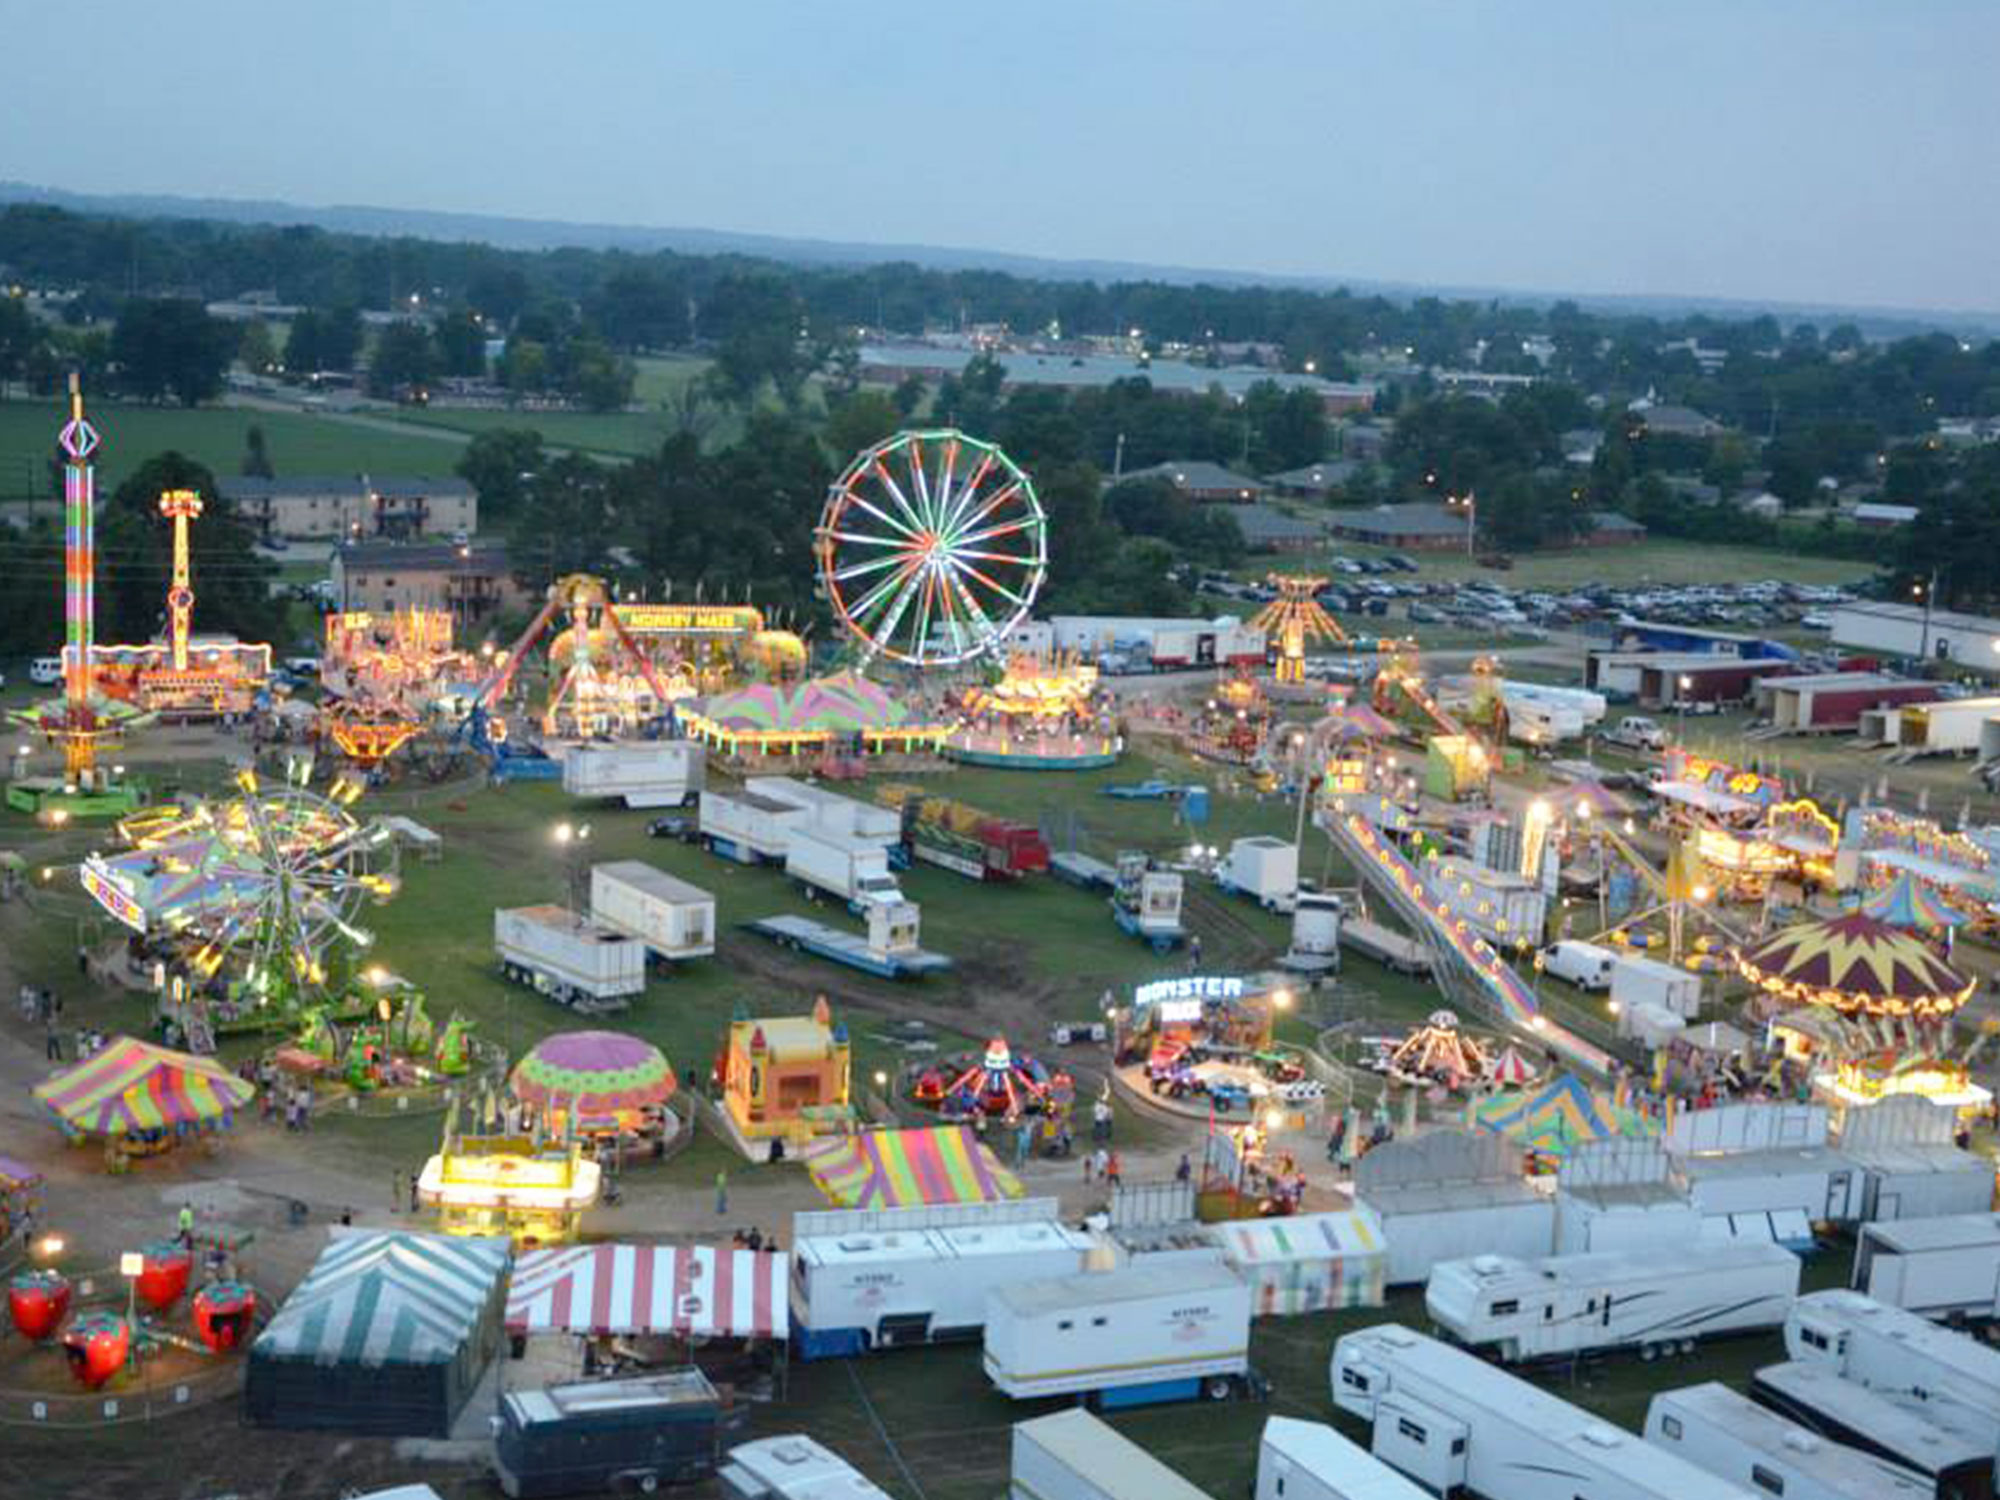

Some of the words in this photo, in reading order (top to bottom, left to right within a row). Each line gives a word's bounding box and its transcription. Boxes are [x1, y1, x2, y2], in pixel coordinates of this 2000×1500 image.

[630, 613, 690, 628] MONKEY
[696, 613, 735, 628] MAZE
[1134, 977, 1242, 1004] MONSTER
